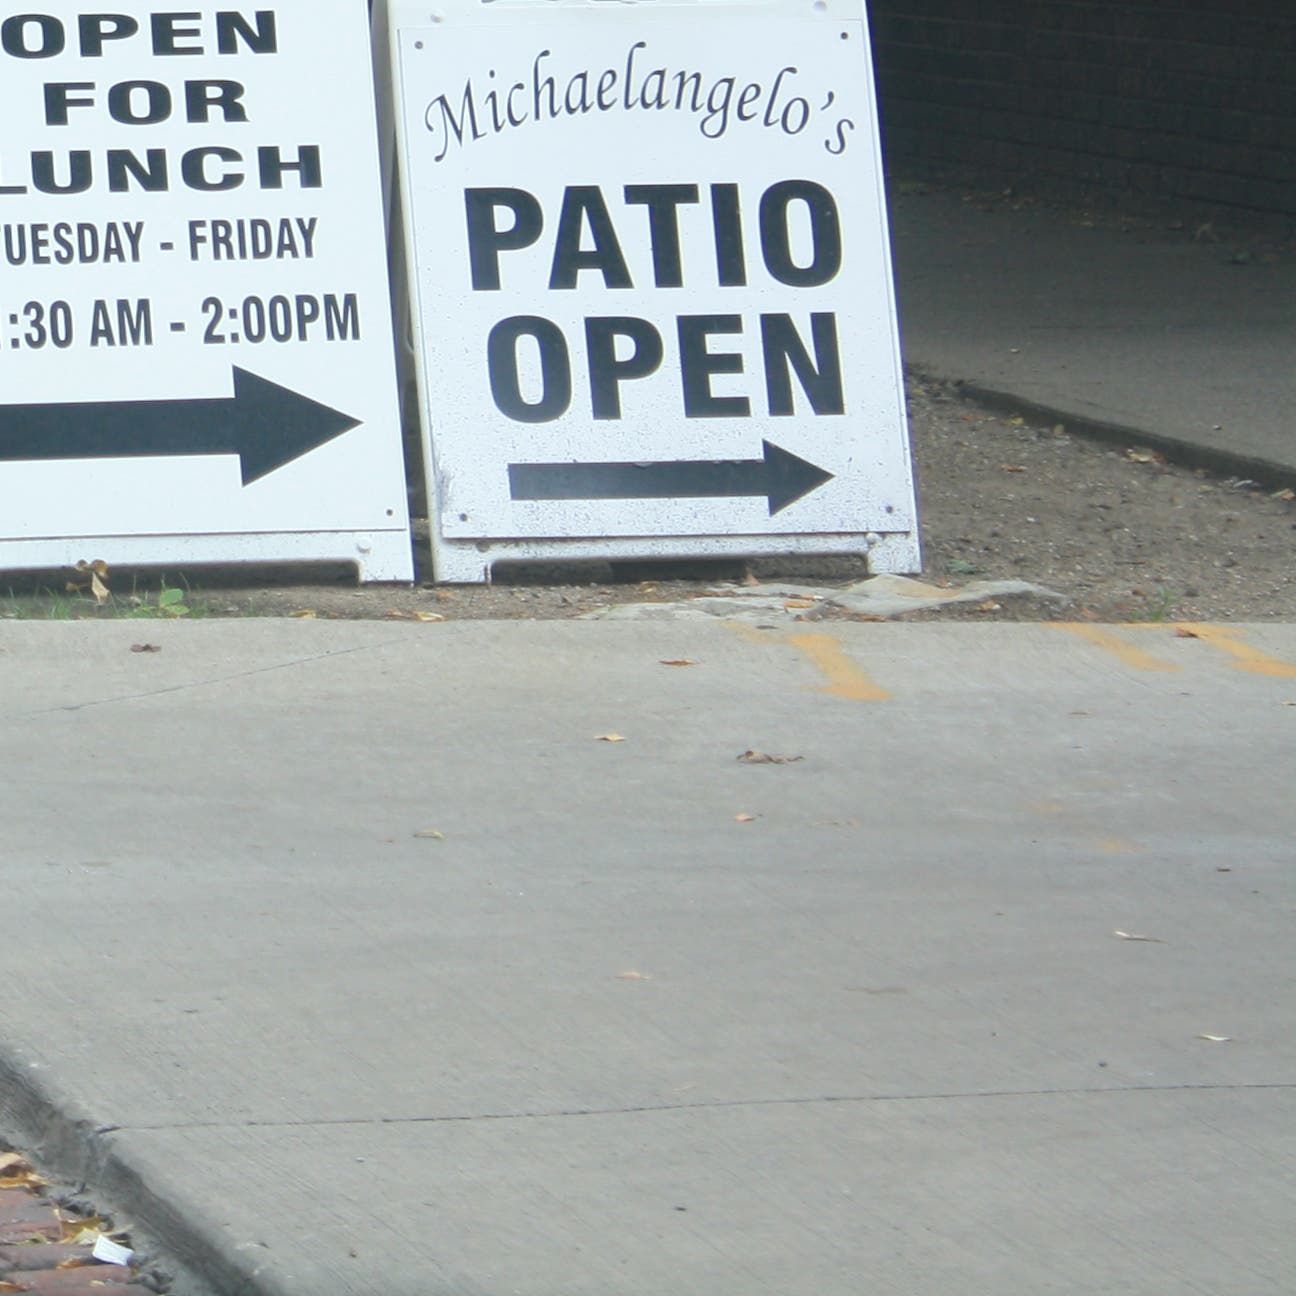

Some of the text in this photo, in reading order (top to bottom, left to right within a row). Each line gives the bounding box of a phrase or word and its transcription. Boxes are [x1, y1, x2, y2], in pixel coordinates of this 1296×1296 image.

[0, 9, 278, 59] OPEN
[42, 78, 250, 127] FOR
[423, 41, 856, 163] Michaelangelo's
[187, 216, 318, 262] FRIDAY
[463, 178, 843, 292] PATIO
[89, 297, 154, 348] AM
[200, 292, 361, 345] 2:00PM
[486, 310, 846, 424] OPEN
